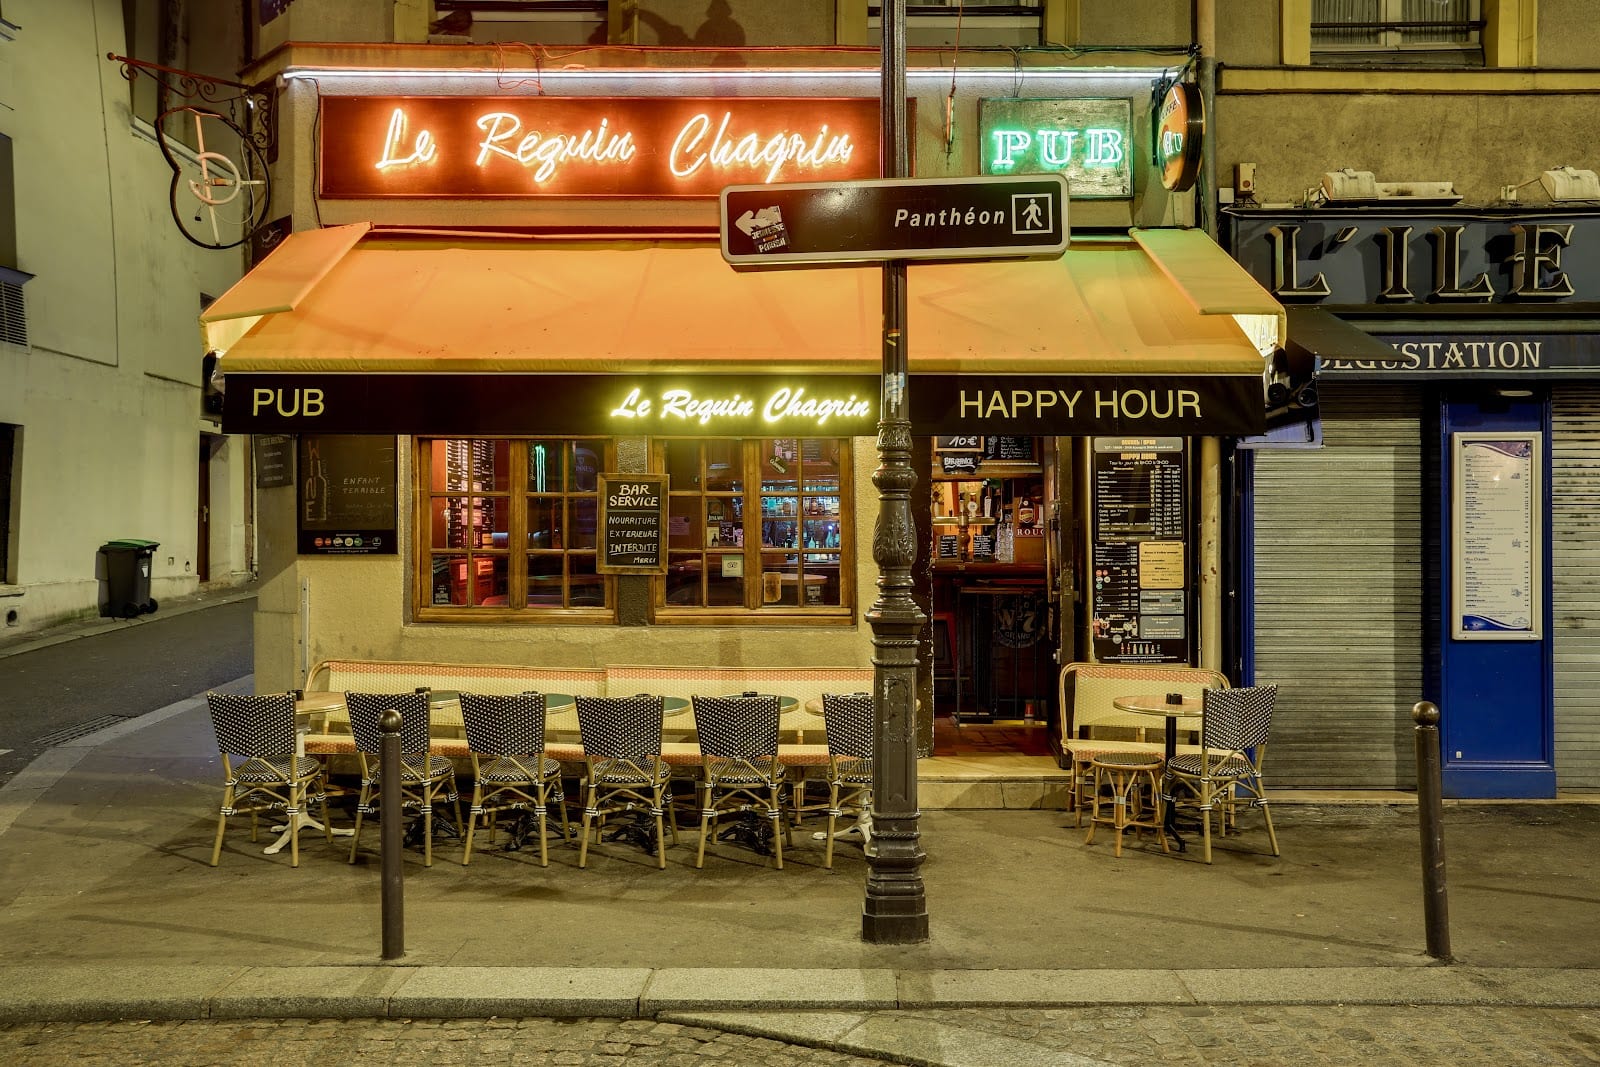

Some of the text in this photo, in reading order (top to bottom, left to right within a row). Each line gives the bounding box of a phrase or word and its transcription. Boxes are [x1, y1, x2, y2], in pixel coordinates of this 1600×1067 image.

[374, 108, 854, 184] Le Requin Chagrin
[991, 128, 1124, 167] PUB
[894, 206, 1006, 229] Panthéon
[1267, 223, 1576, 299] L'ILE
[252, 388, 325, 417] PUB
[610, 387, 870, 425] Le Requin Chagrin
[959, 389, 1203, 419] HAPPY HOUR
[609, 495, 659, 507] SERVICE
[618, 484, 652, 496] BAR
[608, 515, 658, 525] NOURRITURE
[609, 529, 659, 538] EXTERIEURE
[609, 543, 658, 553] INTERDITE
